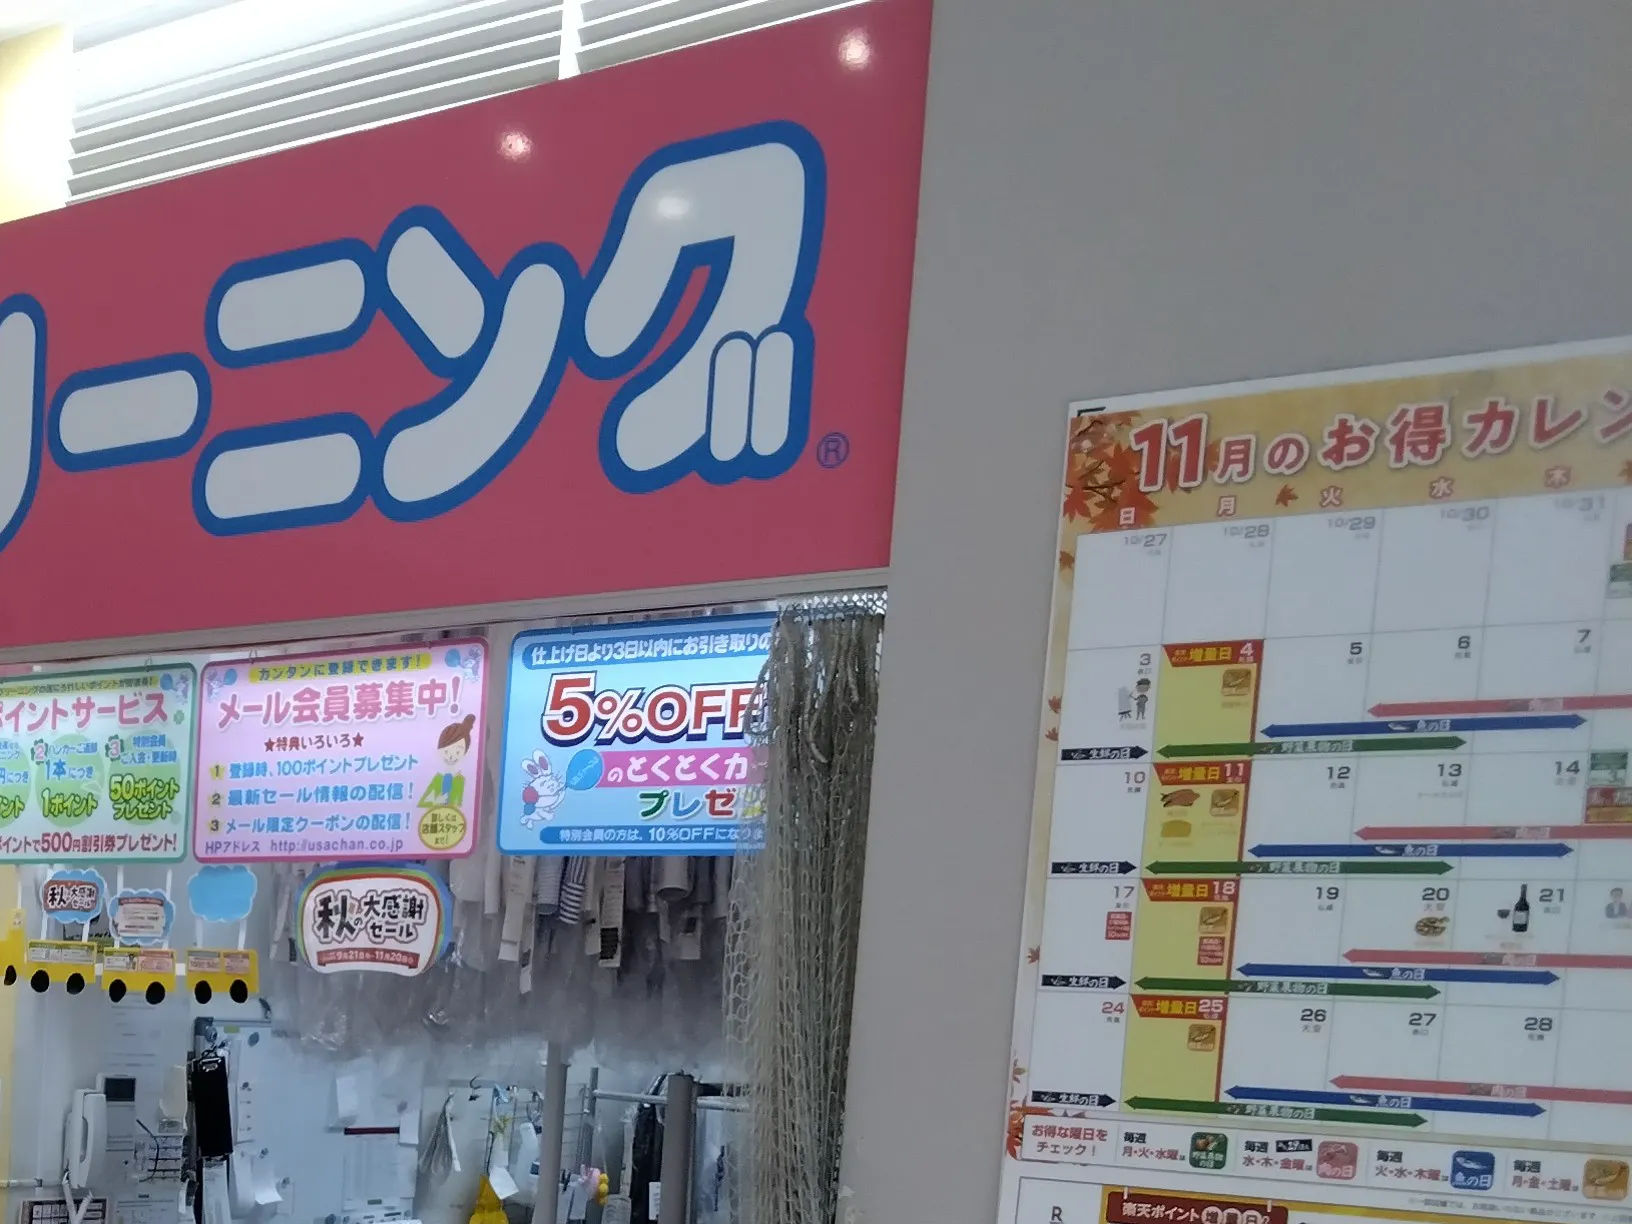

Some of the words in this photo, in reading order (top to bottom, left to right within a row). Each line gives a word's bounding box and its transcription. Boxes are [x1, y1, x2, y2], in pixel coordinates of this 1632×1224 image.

[1544, 466, 1570, 488] 木
[1429, 476, 1454, 499] 水
[1320, 487, 1342, 507] 火
[1217, 496, 1236, 516] 月
[1119, 507, 1135, 526] 日
[1457, 635, 1471, 649] 6
[1577, 629, 1591, 643] 7
[1240, 642, 1253, 656] 4
[1349, 642, 1363, 655] 5
[1139, 653, 1151, 665] 3
[218, 676, 461, 729] メール会員募集中!
[541, 670, 763, 747] 5%OFF
[45, 758, 94, 780] 1本につき
[1178, 767, 1221, 781] 増量日
[1224, 763, 1245, 777] 11
[1327, 766, 1350, 780] 12
[1437, 763, 1462, 777] 13
[1554, 760, 1580, 776] 14
[1124, 771, 1146, 784] 10
[109, 773, 180, 801] 50ポイント
[42, 788, 98, 817] 1ポイント
[114, 802, 173, 820] プレゼント
[205, 841, 261, 854] HPアドレス
[270, 838, 403, 853] http://usachan.co.jp
[1402, 844, 1439, 857] 魚の日
[1113, 886, 1135, 899] 17
[1167, 883, 1208, 898] 増量日
[1213, 881, 1236, 895] 18
[1316, 886, 1339, 900] 19
[1421, 887, 1450, 901] 20
[1538, 888, 1565, 903] 21
[364, 894, 424, 920] 大感謝
[370, 923, 414, 939] セール
[1390, 968, 1426, 981] 魚の日
[1101, 1001, 1125, 1014] 24
[1156, 1000, 1198, 1014] 増量日
[1198, 999, 1224, 1013] 25
[1300, 1008, 1326, 1022] 26
[1408, 1013, 1437, 1027] 27
[1524, 1017, 1553, 1031] 28
[1375, 1095, 1412, 1109] 魚の日
[1032, 1124, 1108, 1142] お得な曜日を
[1123, 1131, 1146, 1144] 毎週
[1244, 1140, 1268, 1153] 毎週
[1376, 1150, 1403, 1163] 毎週
[1513, 1159, 1541, 1173] 毎週
[1454, 1173, 1492, 1188] 魚の日
[1050, 1206, 1062, 1222] R
